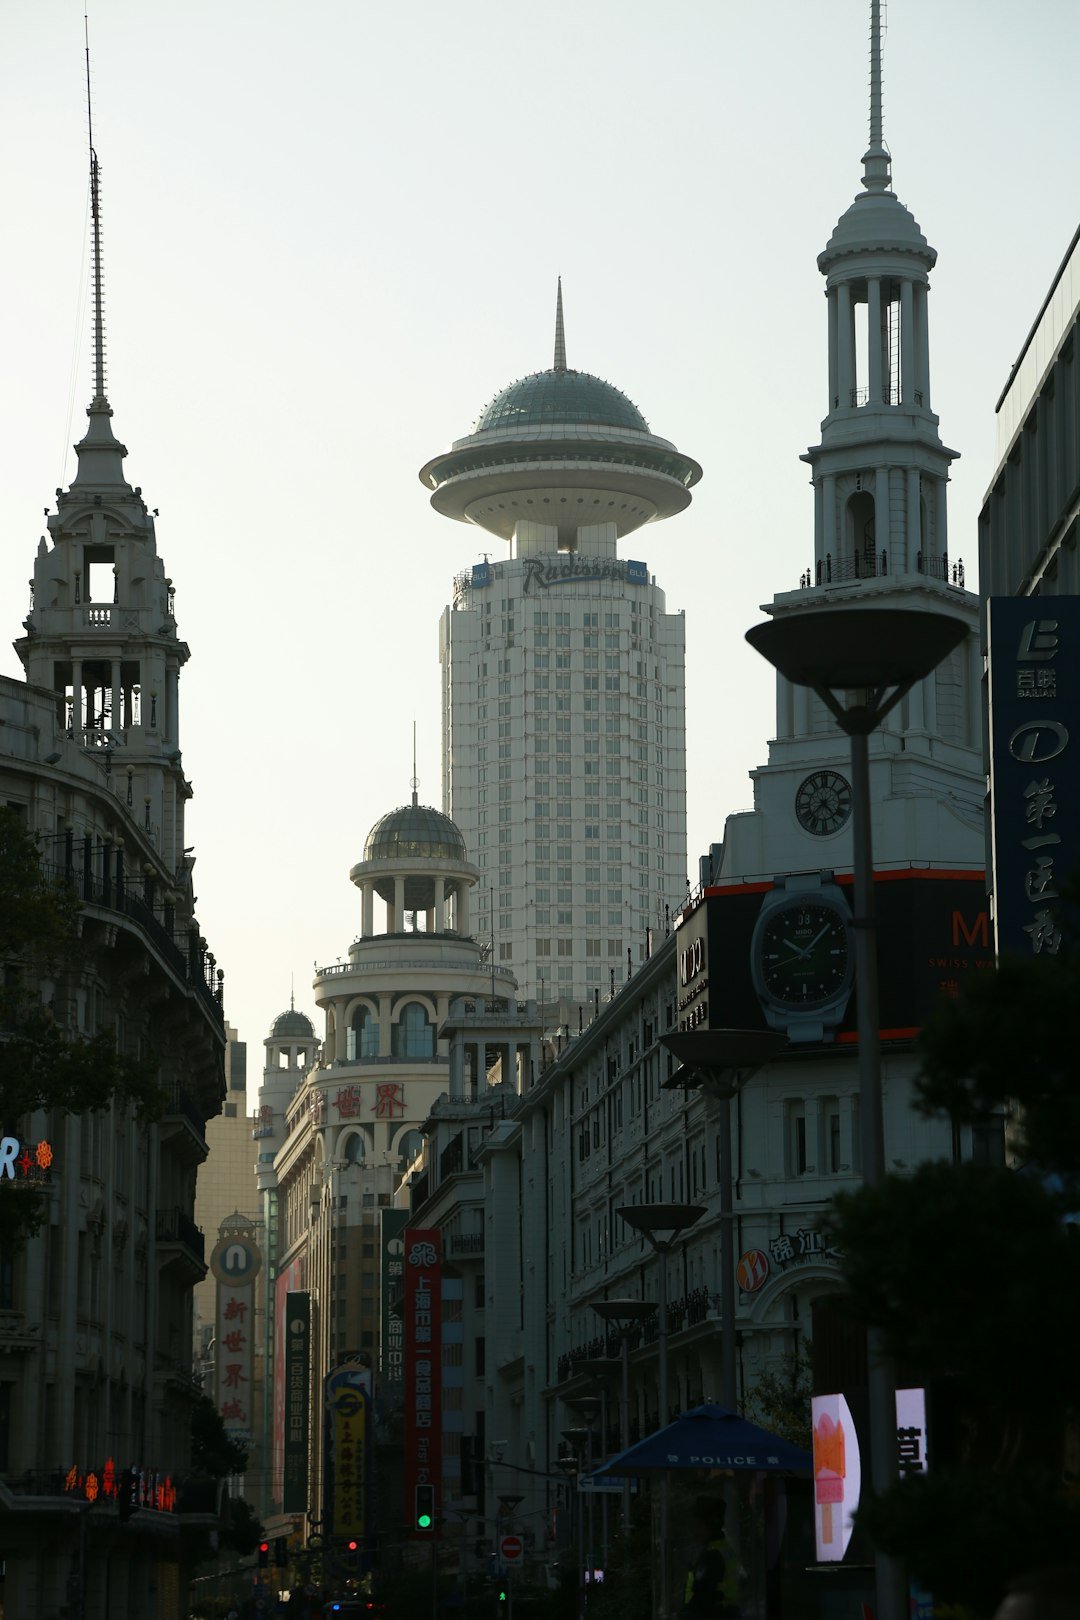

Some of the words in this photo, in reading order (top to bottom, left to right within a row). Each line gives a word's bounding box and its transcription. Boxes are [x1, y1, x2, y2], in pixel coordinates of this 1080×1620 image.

[523, 552, 625, 594] Radisson
[629, 568, 646, 578] BLU
[1017, 669, 1056, 688] 百联
[1020, 777, 1062, 955] 第一医药
[928, 958, 968, 968] SWISS
[221, 1297, 248, 1423] 新世界城
[414, 1276, 432, 1428] 上海市第一食品商店
[690, 1456, 756, 1464] POLICE
